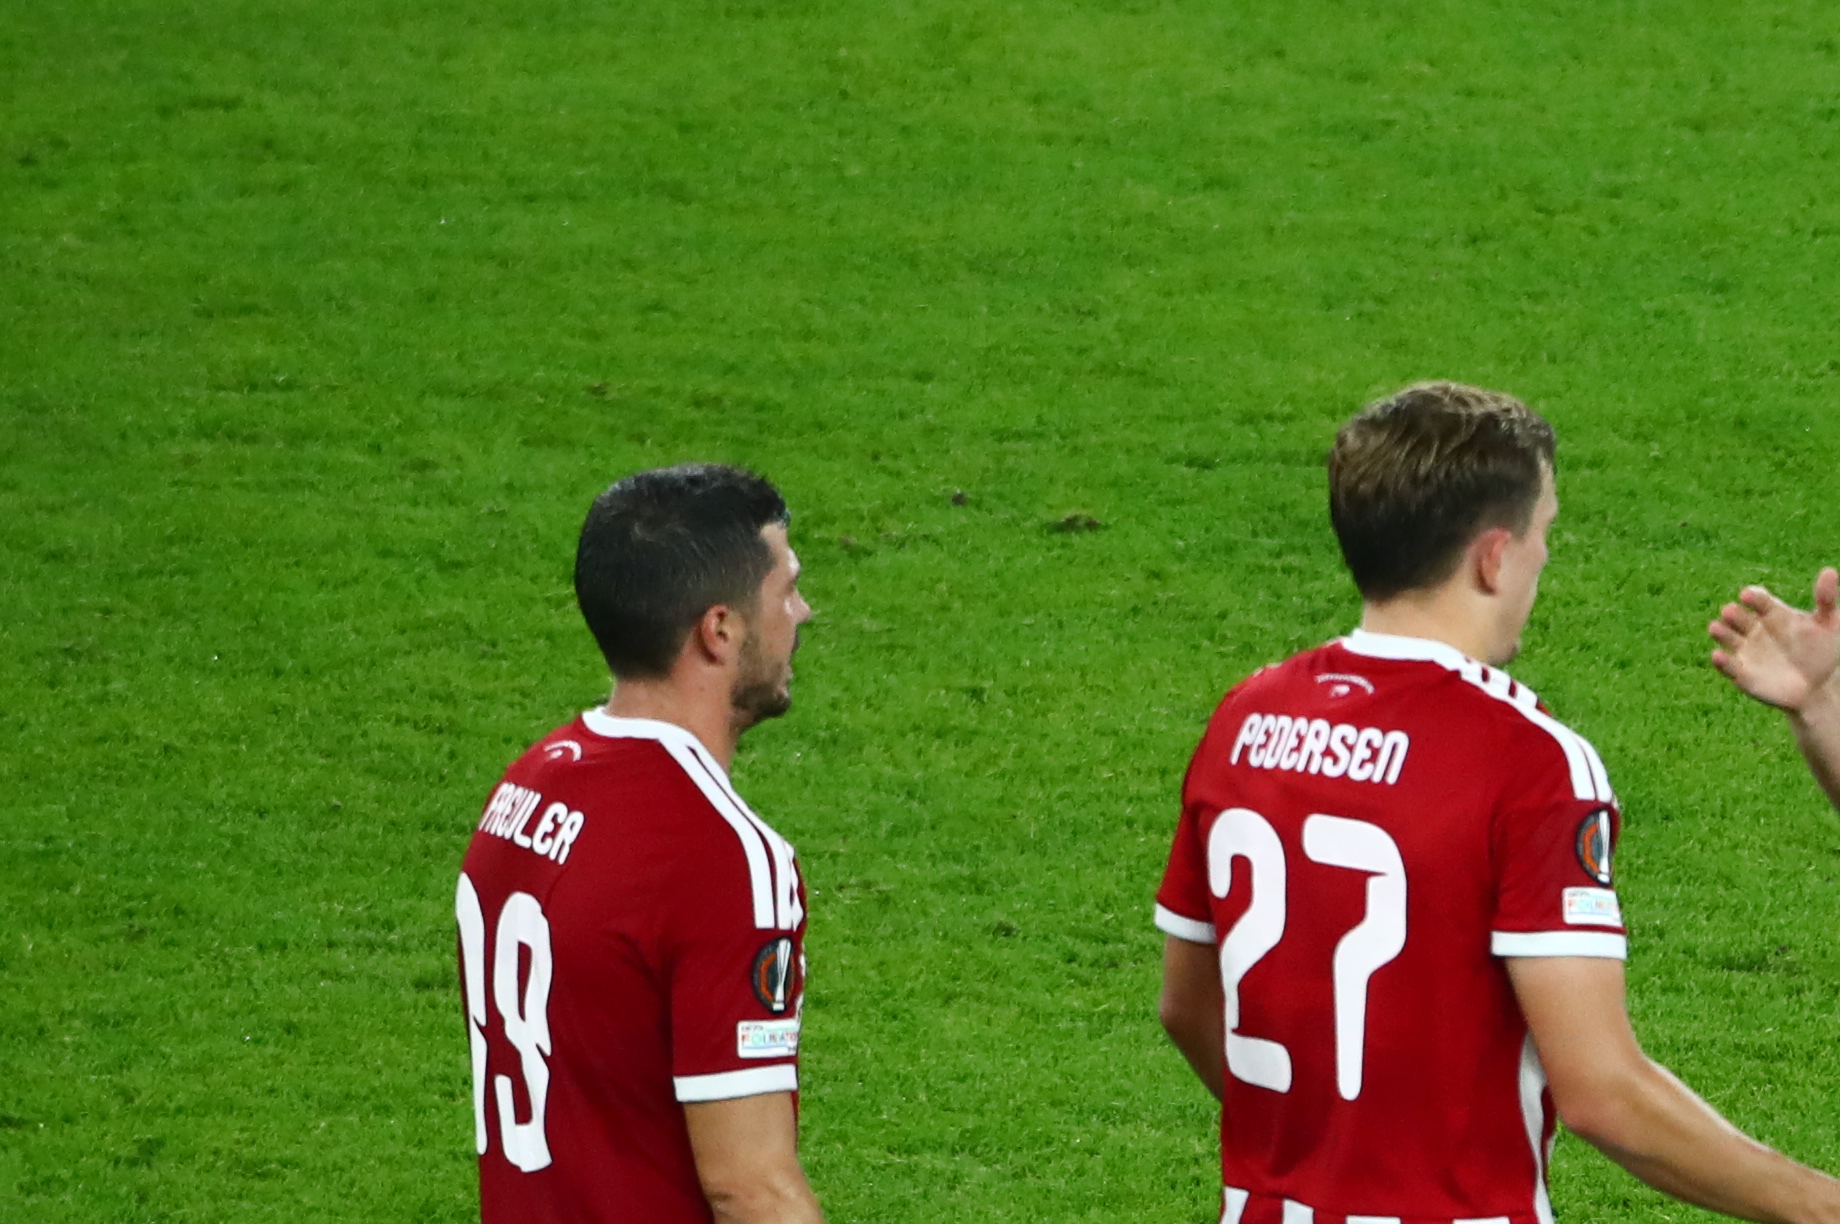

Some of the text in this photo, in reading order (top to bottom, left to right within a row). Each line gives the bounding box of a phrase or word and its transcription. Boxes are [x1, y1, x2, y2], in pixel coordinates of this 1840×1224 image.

[1230, 713, 1409, 785] PEDERSEN
[456, 871, 553, 1173] 19
[1208, 807, 1407, 1101] 27
